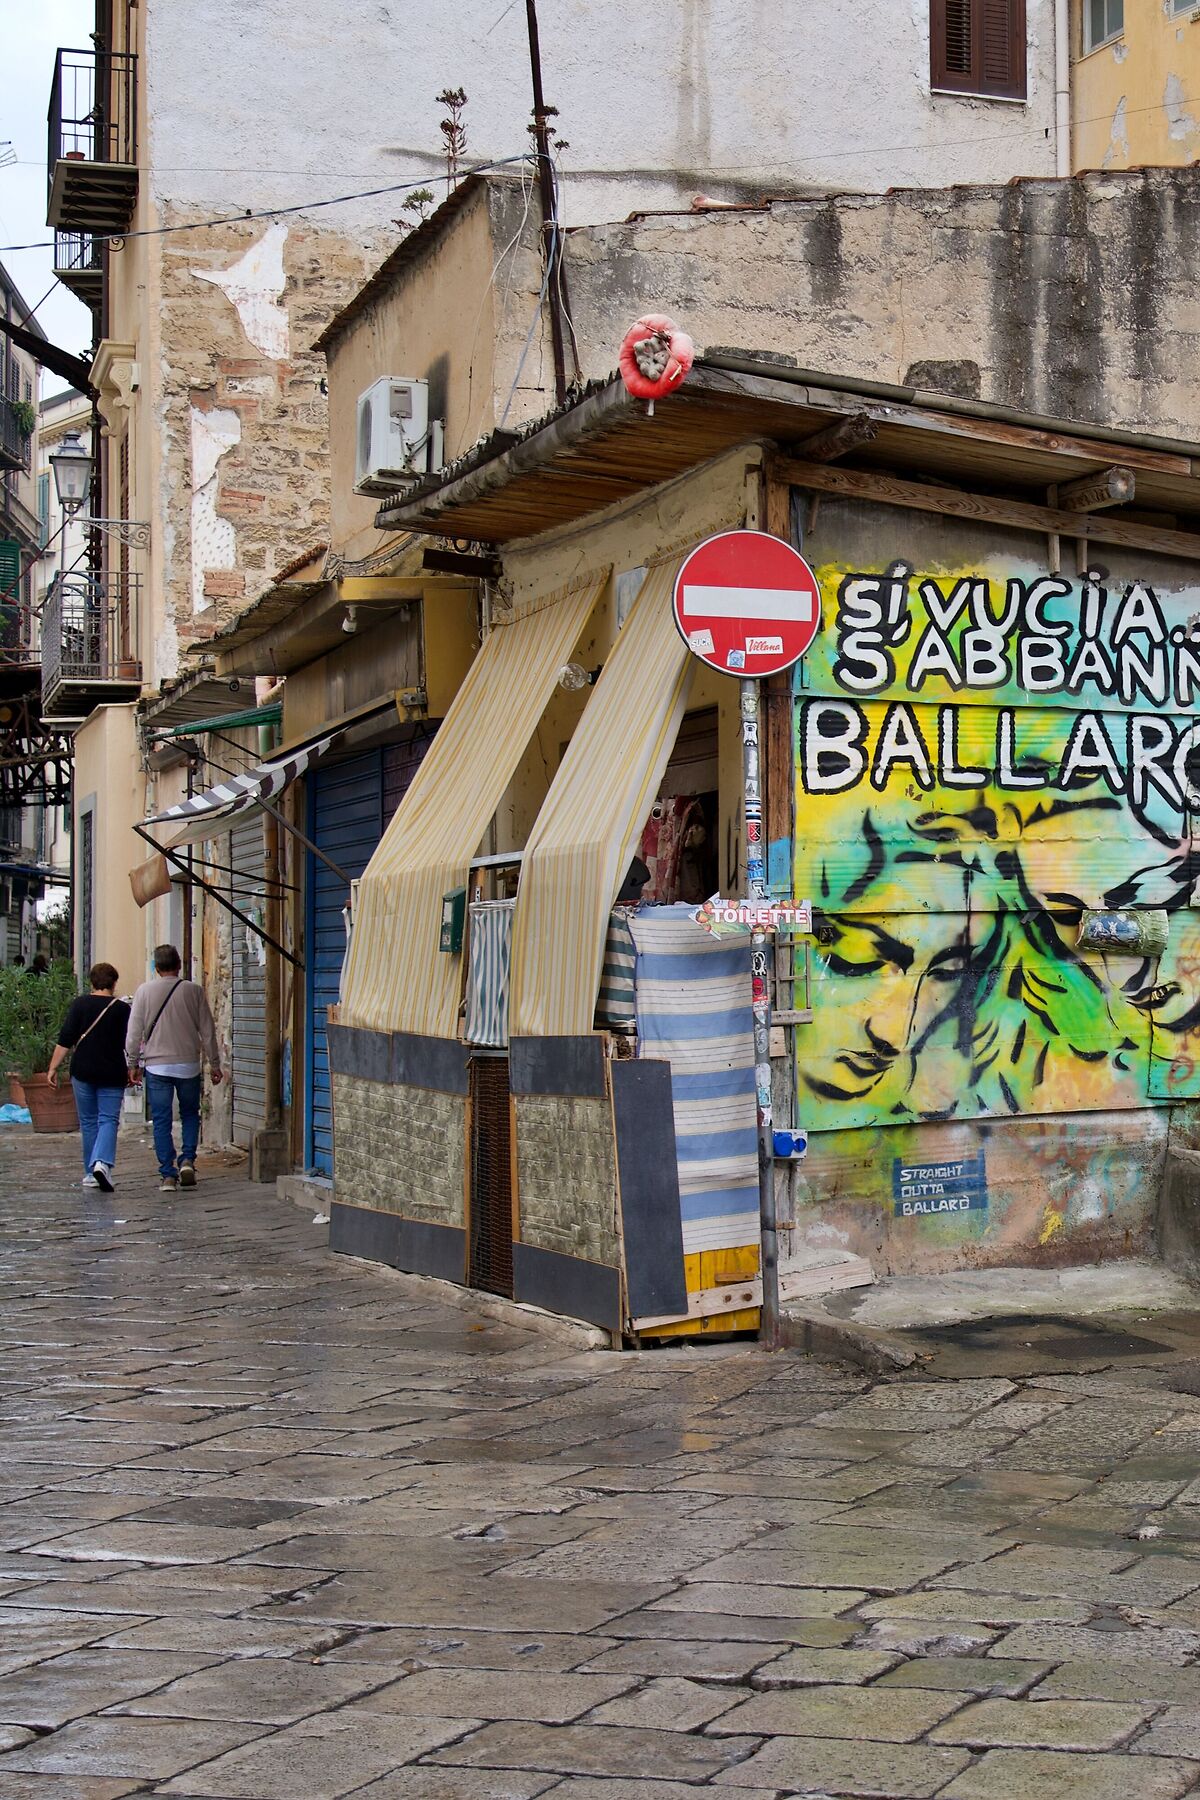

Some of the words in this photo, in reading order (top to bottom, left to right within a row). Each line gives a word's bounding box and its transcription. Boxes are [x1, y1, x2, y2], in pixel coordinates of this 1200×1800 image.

[711, 908, 807, 924] TOILETTE
[900, 1165, 963, 1182] STRAIGHT
[901, 1184, 944, 1197] OUTTA
[902, 1195, 970, 1216] BALLARÒ
